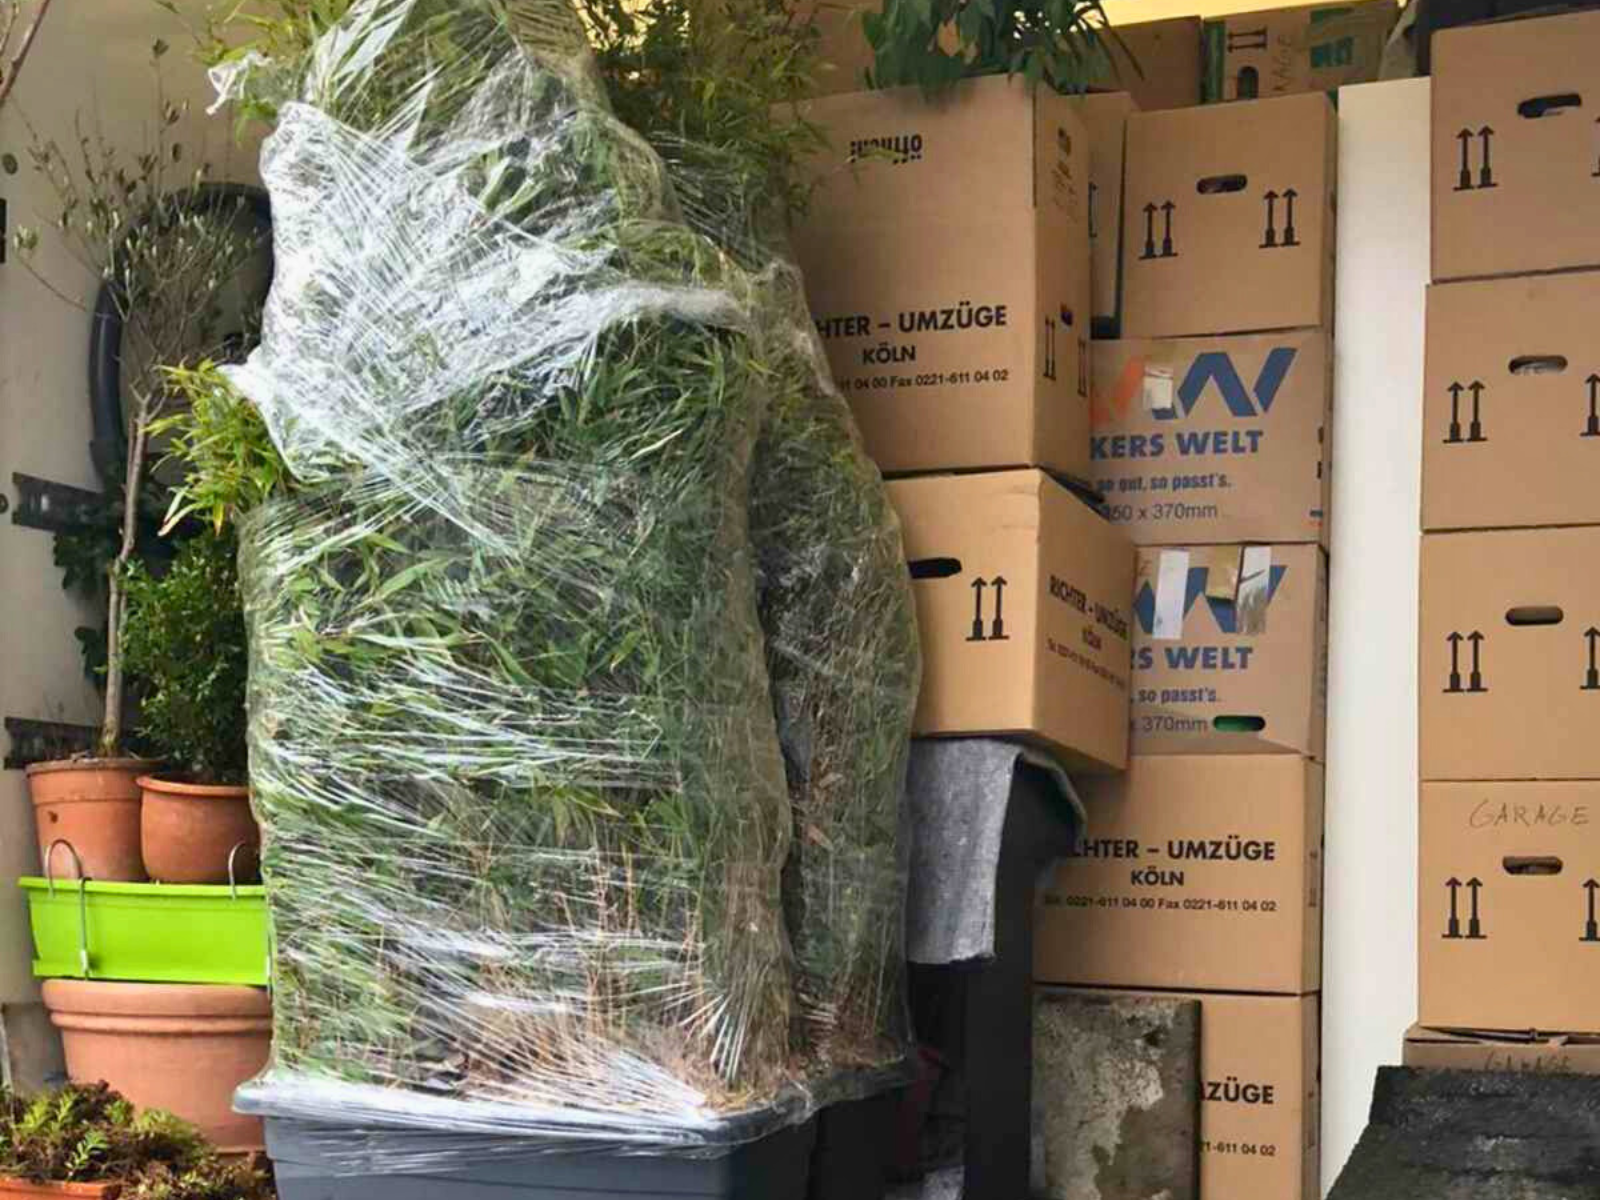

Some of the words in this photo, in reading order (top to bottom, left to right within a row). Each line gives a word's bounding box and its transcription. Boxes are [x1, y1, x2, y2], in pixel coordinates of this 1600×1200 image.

[898, 301, 1007, 333] UMZÜGE
[862, 341, 916, 365] KÖLN
[889, 374, 911, 388] Fax
[915, 371, 971, 387] 0221-611
[974, 370, 990, 383] 04
[992, 369, 1008, 382] 02
[1176, 431, 1264, 455] WELT
[1151, 475, 1168, 489] so
[1138, 507, 1148, 519] x
[1152, 502, 1218, 519] 370mm
[1164, 647, 1253, 670] WELT
[1142, 715, 1209, 731] 370mm
[1468, 798, 1590, 829] GARAGE
[1167, 835, 1276, 861] UMZÜGE
[1130, 865, 1185, 887] KÖLN
[1158, 898, 1180, 910] Fax
[1183, 899, 1238, 911] 0221-611
[1242, 900, 1257, 911] 04
[1260, 900, 1276, 912] 02
[1241, 1143, 1257, 1155] 04
[1260, 1144, 1276, 1157] 02
